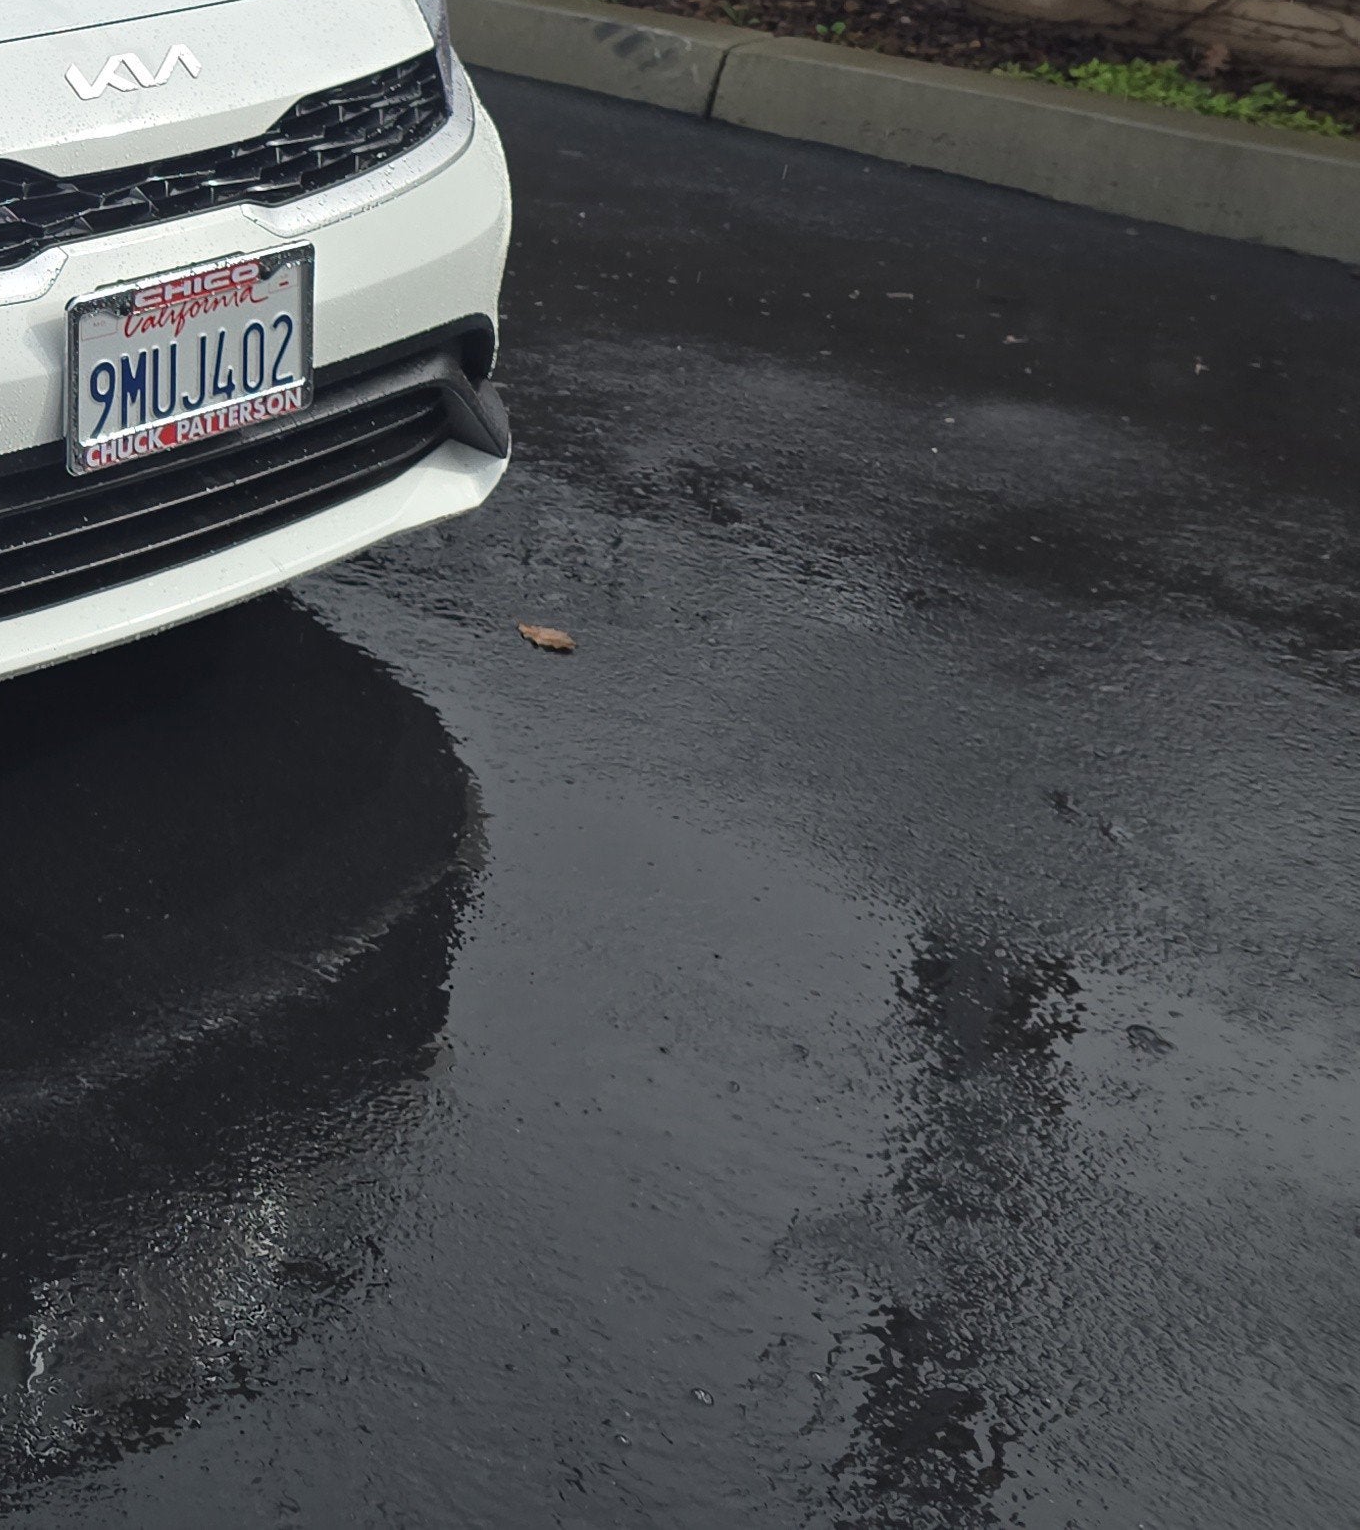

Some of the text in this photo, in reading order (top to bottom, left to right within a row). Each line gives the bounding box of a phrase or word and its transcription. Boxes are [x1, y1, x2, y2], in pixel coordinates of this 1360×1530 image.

[64, 43, 202, 101] KIA
[124, 285, 269, 338] California
[134, 262, 260, 308] CHICO
[89, 314, 294, 439] 9MUJ402
[86, 386, 302, 468] CHUCK PATTERSON
